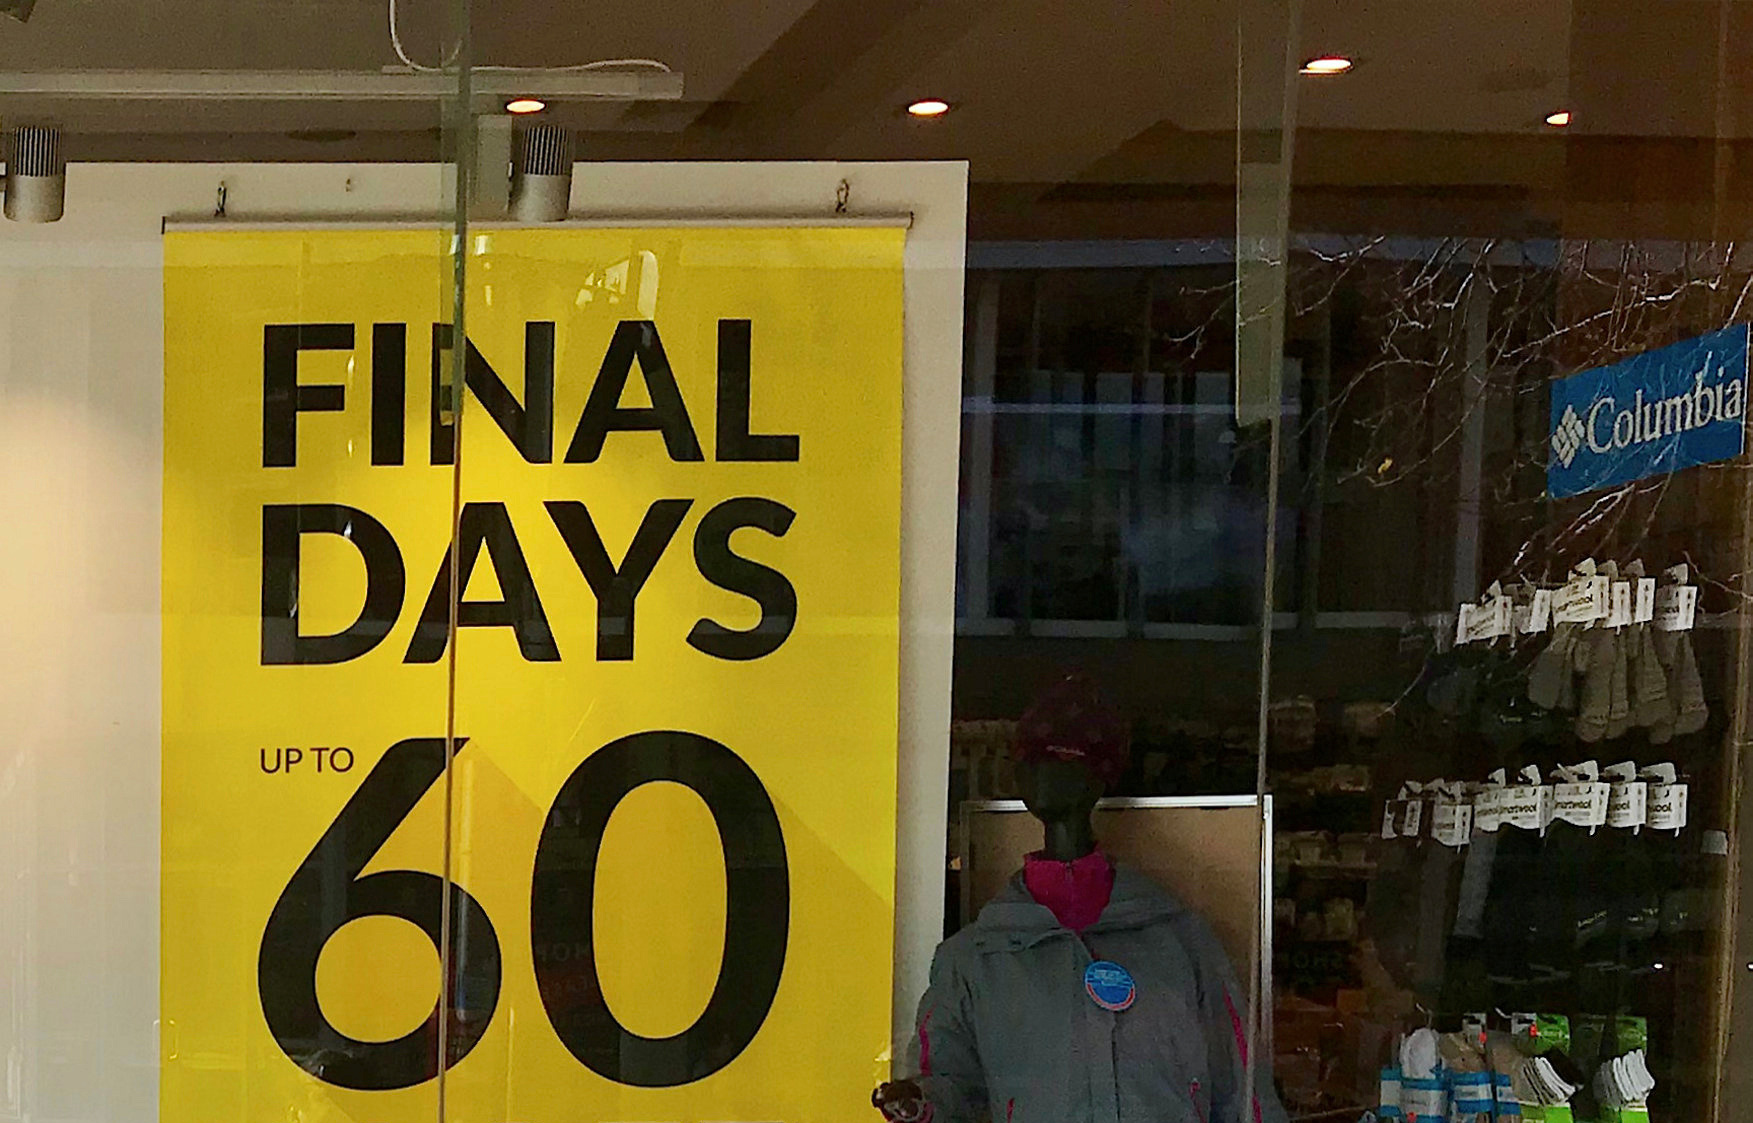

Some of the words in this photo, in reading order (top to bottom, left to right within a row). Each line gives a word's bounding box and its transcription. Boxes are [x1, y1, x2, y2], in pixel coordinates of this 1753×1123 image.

[262, 319, 801, 468] FINAL
[1587, 366, 1742, 454] Columbia
[261, 497, 798, 666] DAYS
[259, 747, 303, 774] UP
[310, 746, 355, 773] TO
[257, 729, 791, 1091] 60
